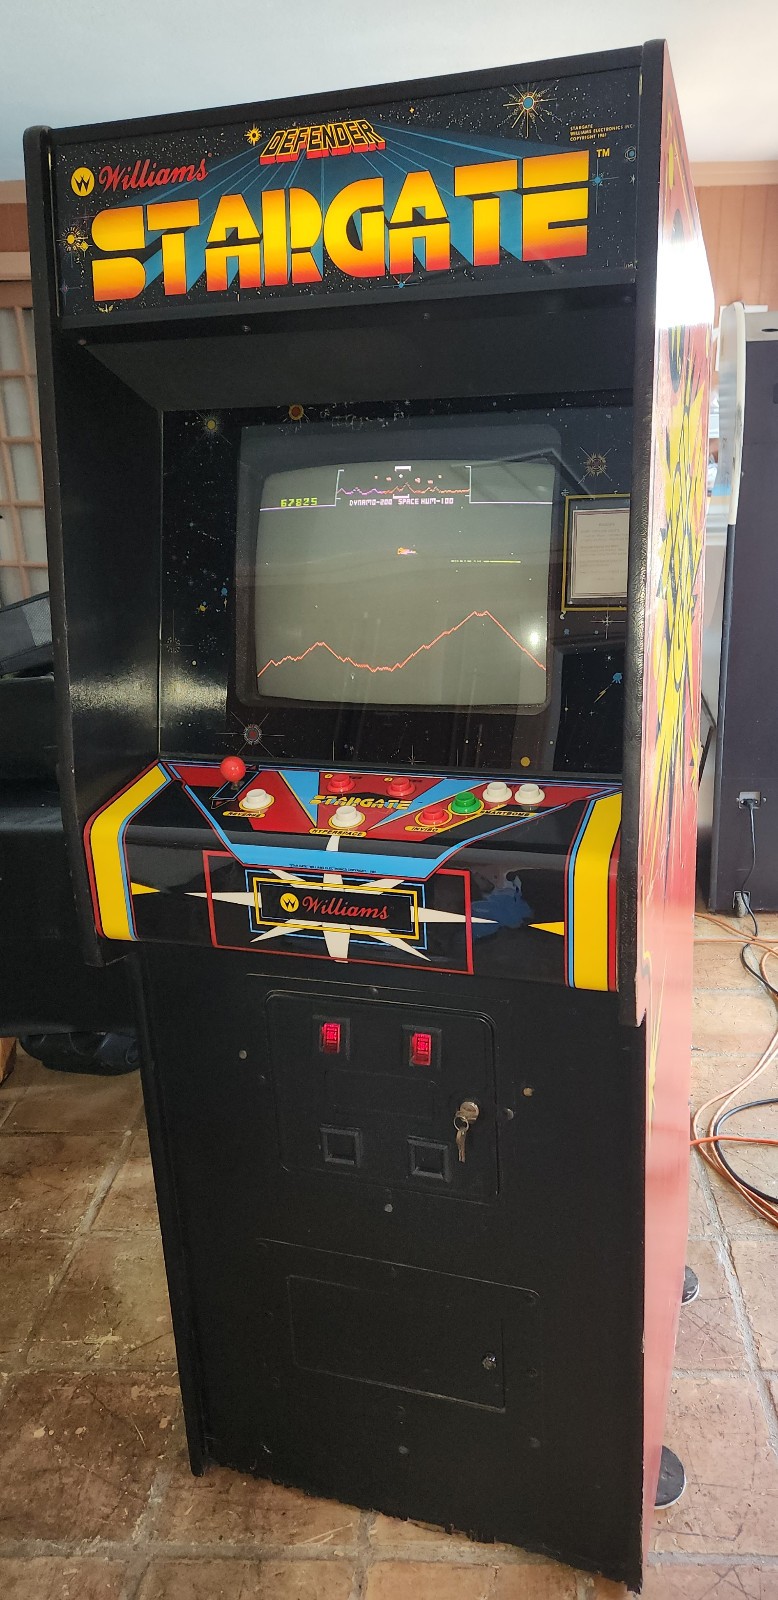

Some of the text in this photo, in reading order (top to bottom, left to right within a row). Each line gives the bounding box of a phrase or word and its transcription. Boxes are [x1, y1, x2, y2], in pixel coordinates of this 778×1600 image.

[260, 119, 386, 165] DEFENDER
[569, 133, 596, 142] COPYRIGHT
[597, 148, 610, 158] TM
[99, 158, 208, 192] Williams
[90, 149, 591, 302] STARGATE
[280, 498, 318, 508] 67825
[349, 498, 393, 506] DYNAMO-200
[420, 497, 454, 505] HUM-100
[308, 795, 413, 811] STARGATE
[301, 895, 389, 920] Williams
